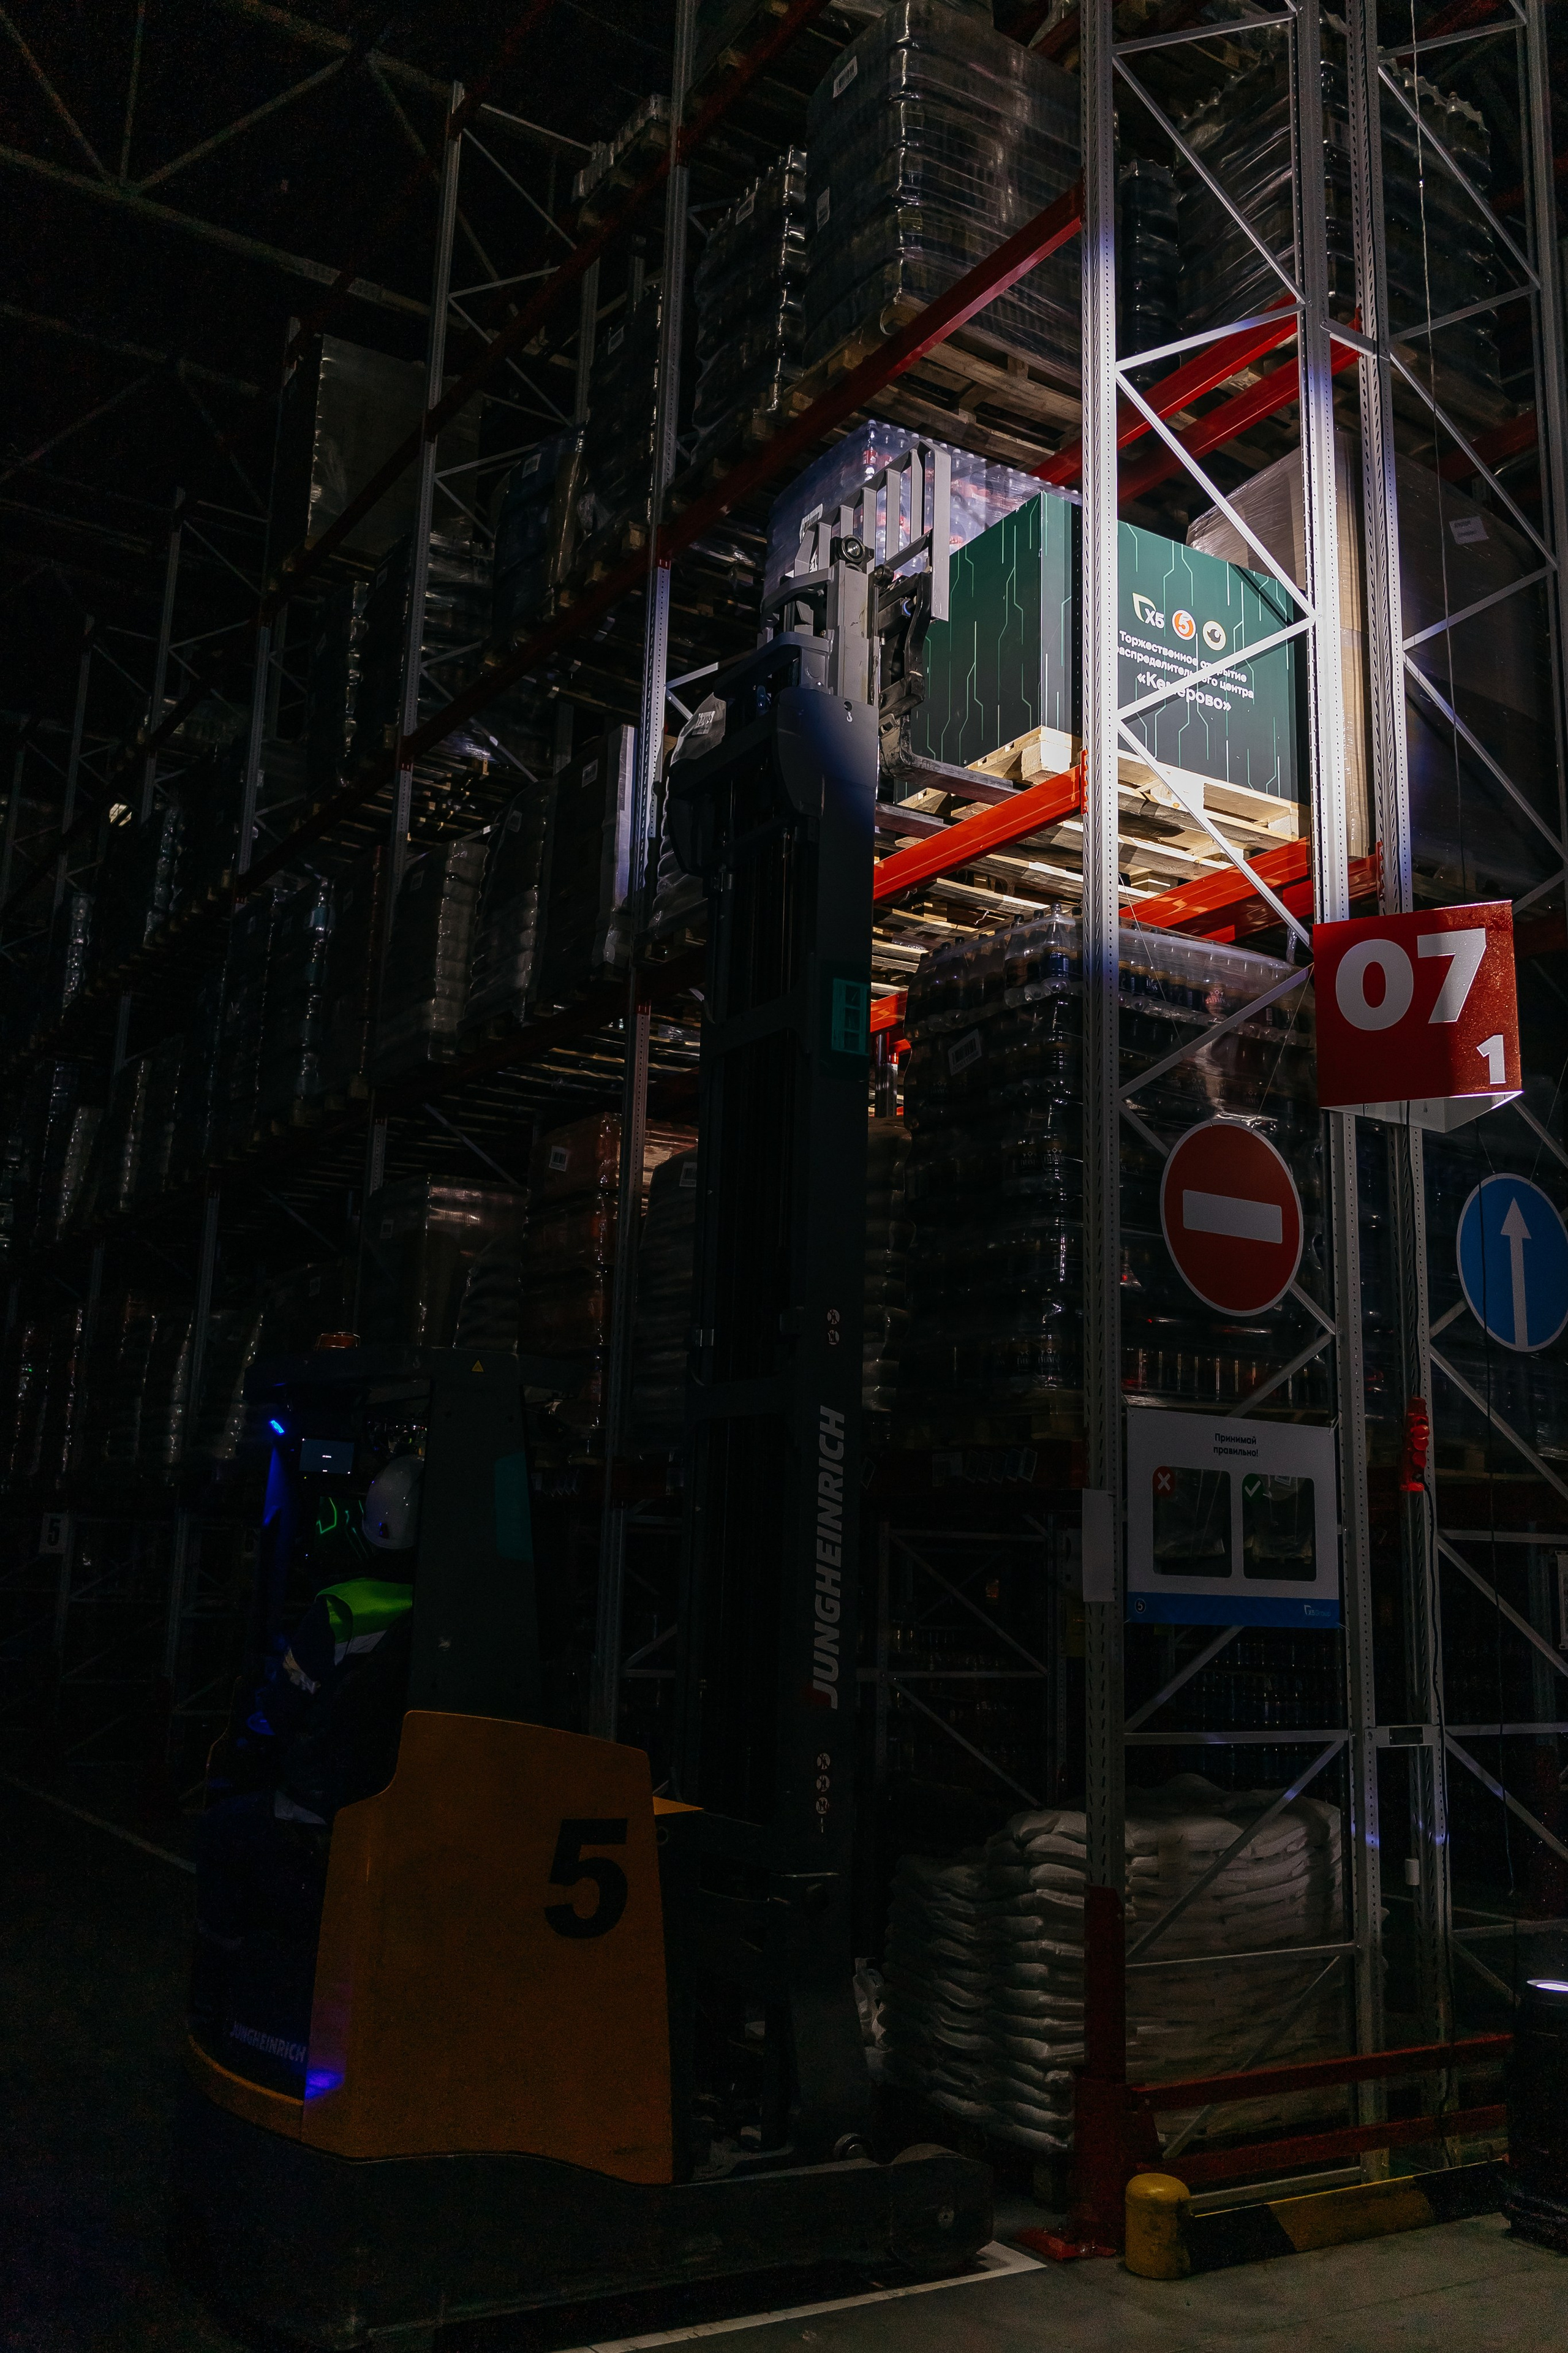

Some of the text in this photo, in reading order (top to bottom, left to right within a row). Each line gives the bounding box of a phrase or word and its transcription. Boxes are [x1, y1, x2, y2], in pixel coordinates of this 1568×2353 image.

[1144, 608, 1165, 629] X5
[1175, 613, 1193, 637] 5
[1119, 630, 1198, 667] Торжественное
[1137, 671, 1232, 711] «Кеерово»
[1219, 680, 1254, 698] центра
[1335, 927, 1487, 1031] 07
[1476, 1035, 1506, 1084] 1
[1213, 1446, 1258, 1457] правильно!
[1215, 1433, 1256, 1445] Принимай
[813, 1405, 845, 1710] JUNGHEINRICH
[544, 1819, 628, 1939] 5
[230, 2022, 306, 2063] JUNGHEINRICH
